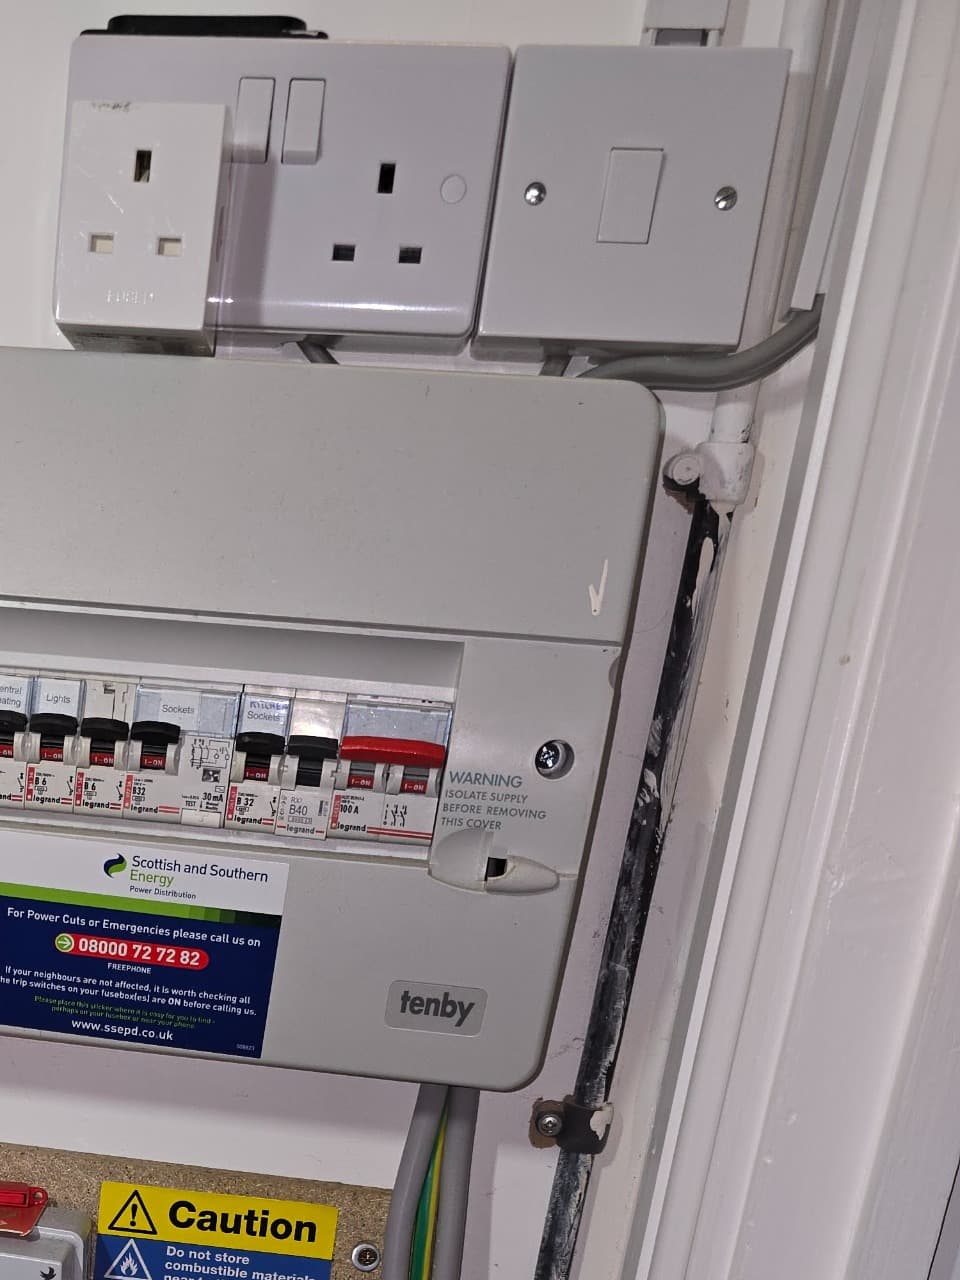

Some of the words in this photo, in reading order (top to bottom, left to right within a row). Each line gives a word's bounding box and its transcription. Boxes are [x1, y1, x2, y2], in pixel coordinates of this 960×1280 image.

[46, 694, 72, 704] Lights
[161, 704, 195, 714] Sockets
[247, 710, 281, 722] Sockets
[448, 770, 523, 789] WARNING
[444, 789, 488, 802] ISOLATE
[490, 791, 528, 804] SUPPLY
[130, 804, 158, 814] legrand
[289, 804, 308, 816] B40
[442, 802, 482, 815] BEFORE
[486, 805, 547, 820] REMOVING
[233, 815, 262, 825] legrand
[286, 823, 315, 835] legrand
[337, 822, 366, 832] legrand
[440, 816, 464, 828] THIS
[466, 818, 502, 831] COVER
[132, 855, 181, 873] Scottish
[183, 864, 208, 876] and
[210, 864, 268, 883] Southern
[130, 869, 175, 888] Energy
[129, 885, 152, 895] Power
[154, 888, 197, 900] Distribution
[7, 907, 24, 918] For
[27, 909, 60, 922] Power
[62, 914, 86, 926] Cuts
[88, 919, 100, 928] or
[102, 919, 170, 936] Emergencies
[172, 928, 208, 940] please
[210, 933, 230, 944] call
[232, 937, 245, 945] us
[247, 938, 261, 947] on
[78, 938, 128, 957] 08000
[132, 943, 152, 960] 72
[156, 947, 176, 963] 72
[179, 950, 200, 966] 82
[107, 962, 152, 975] FREEPHONE
[12, 968, 32, 978] your
[33, 970, 81, 983] neighbours
[82, 977, 97, 985] are
[98, 978, 113, 987] not
[114, 980, 152, 993] affected,
[171, 988, 197, 998] worth
[198, 991, 237, 1004] checking
[239, 996, 251, 1004] all
[12, 978, 28, 988] trip
[29, 980, 66, 992] switches
[79, 987, 100, 997] your
[151, 996, 166, 1004] are
[167, 998, 182, 1007] ON
[183, 1000, 211, 1011] before
[212, 1004, 242, 1016] calling
[399, 990, 475, 1027] tenby
[71, 1019, 174, 1041] www.ssepd.co.uk
[168, 1199, 318, 1243] Caution
[166, 1246, 185, 1257] Do
[188, 1250, 211, 1260] not
[214, 1252, 250, 1265] store
[164, 1261, 248, 1279] combustible
